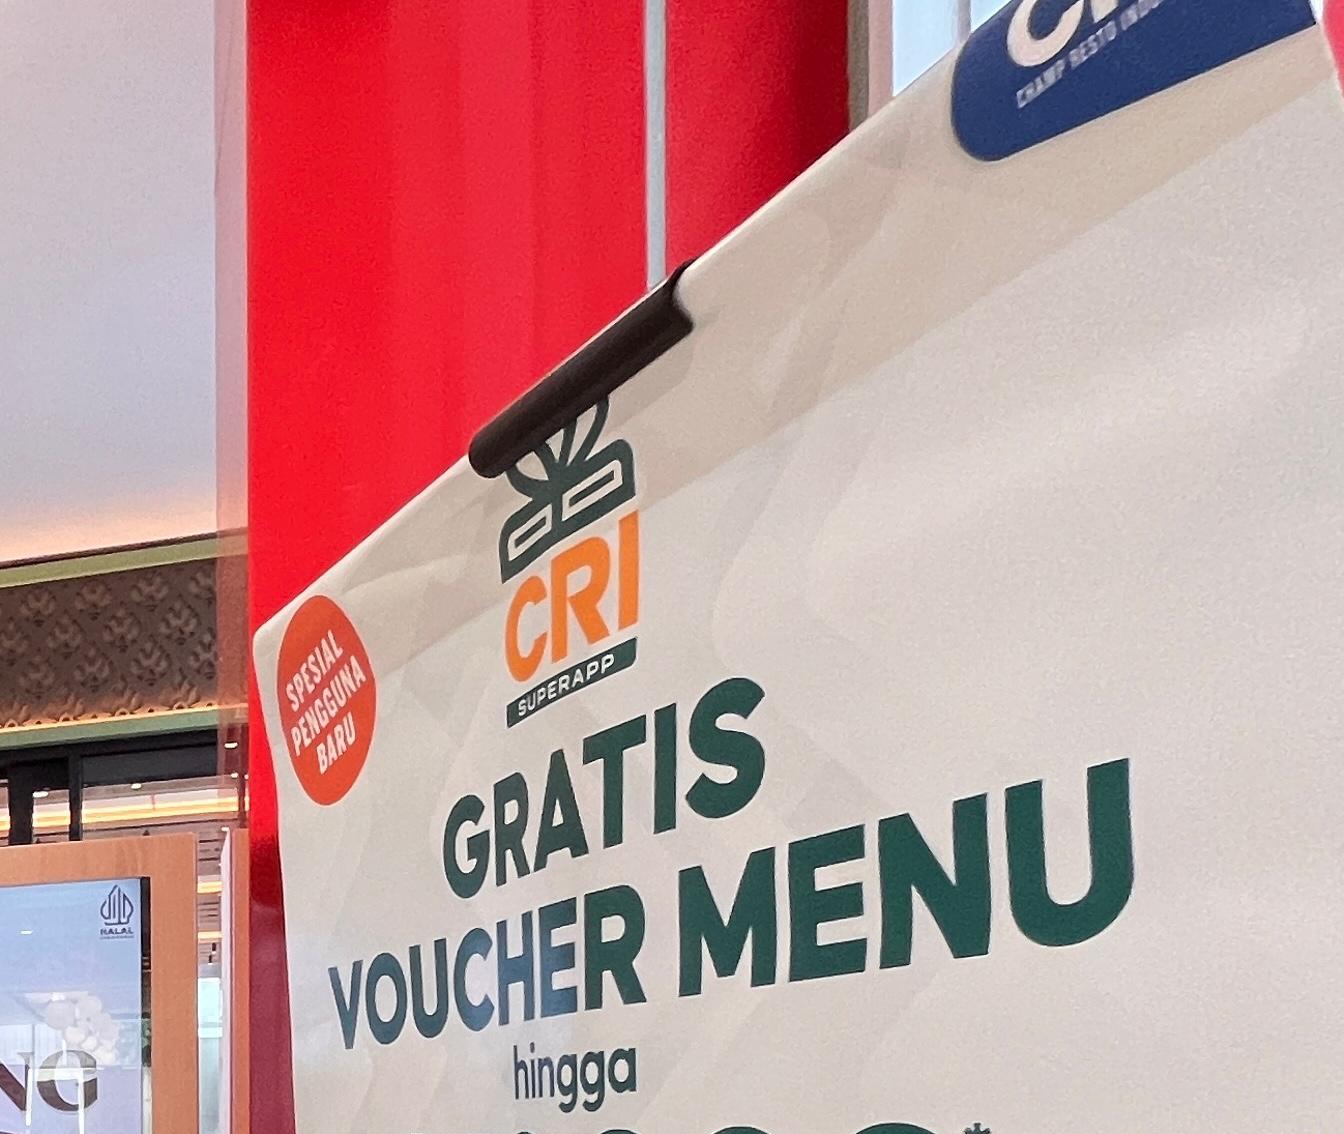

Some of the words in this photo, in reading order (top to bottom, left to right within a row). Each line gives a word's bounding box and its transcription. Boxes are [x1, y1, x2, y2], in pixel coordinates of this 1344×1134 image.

[505, 510, 638, 682] CRI
[286, 630, 343, 711] SPESIAL
[291, 655, 366, 756] PENGGUNA
[518, 654, 614, 716] SUPERAPP
[316, 712, 356, 774] BARU
[443, 677, 765, 899] GRATIS
[328, 885, 646, 1049] VOUCHER
[678, 757, 1134, 999] MENU
[513, 1044, 637, 1113] hingga
